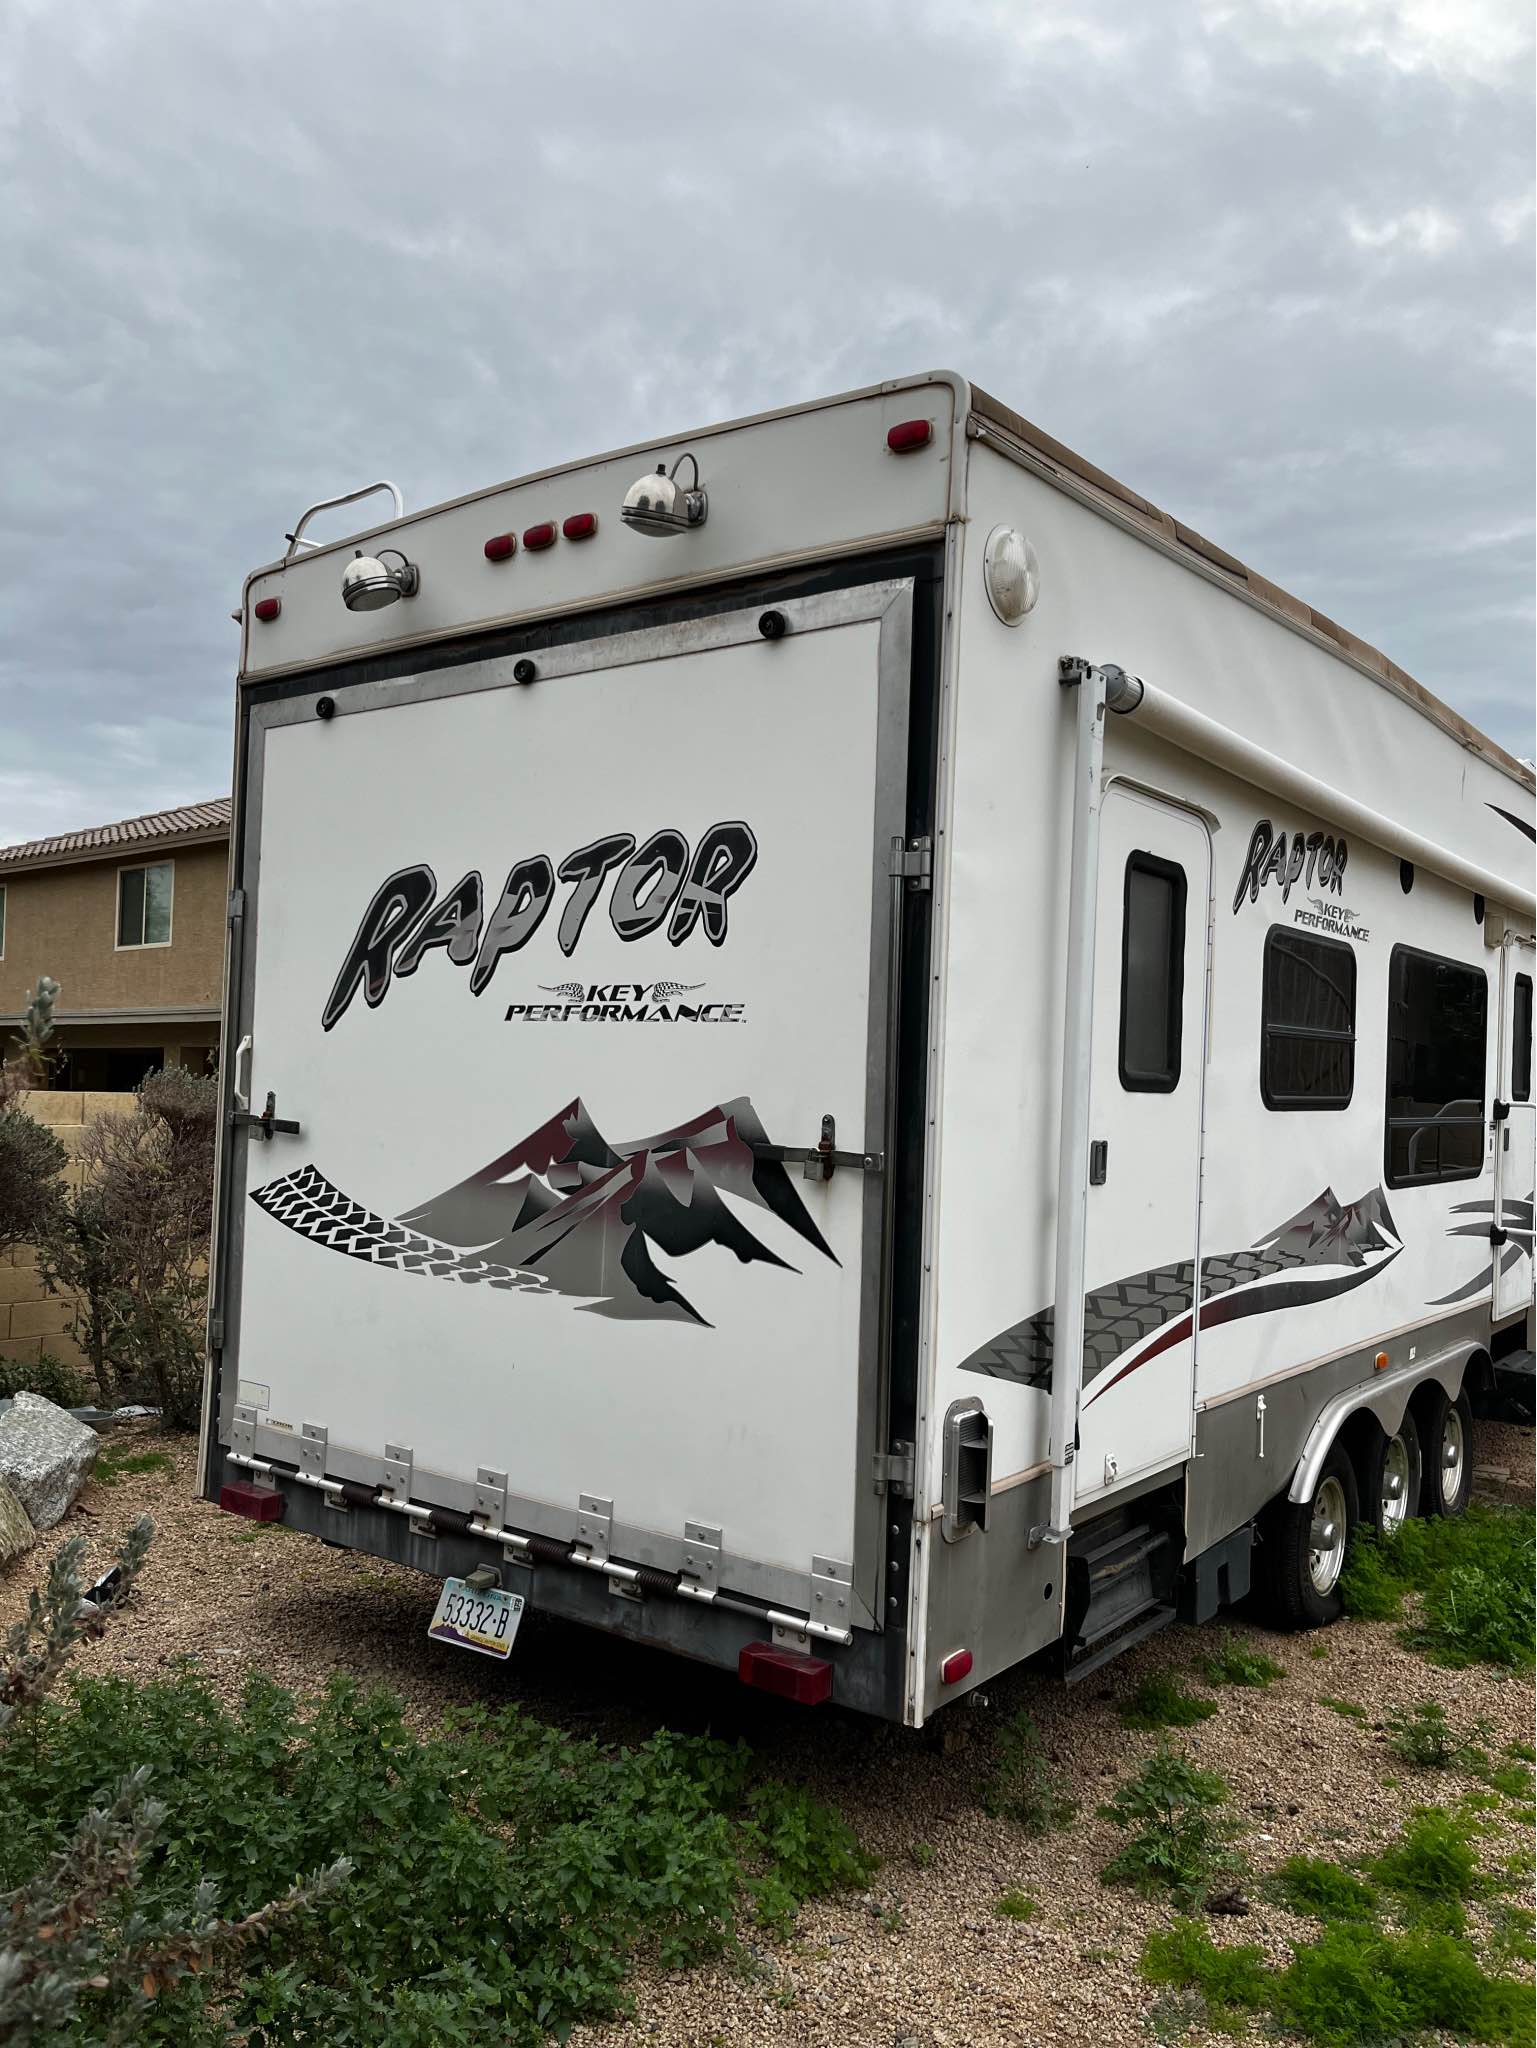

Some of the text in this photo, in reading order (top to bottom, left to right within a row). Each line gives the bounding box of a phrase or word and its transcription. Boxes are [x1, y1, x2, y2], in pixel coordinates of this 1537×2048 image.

[1232, 819, 1348, 915] RAPTOR
[1323, 903, 1345, 921] KEY
[322, 821, 757, 1032] RAPTOR
[1294, 909, 1369, 942] PERFORMANCE
[586, 984, 654, 1002] KEY
[504, 1003, 746, 1023] PERFORMANCE
